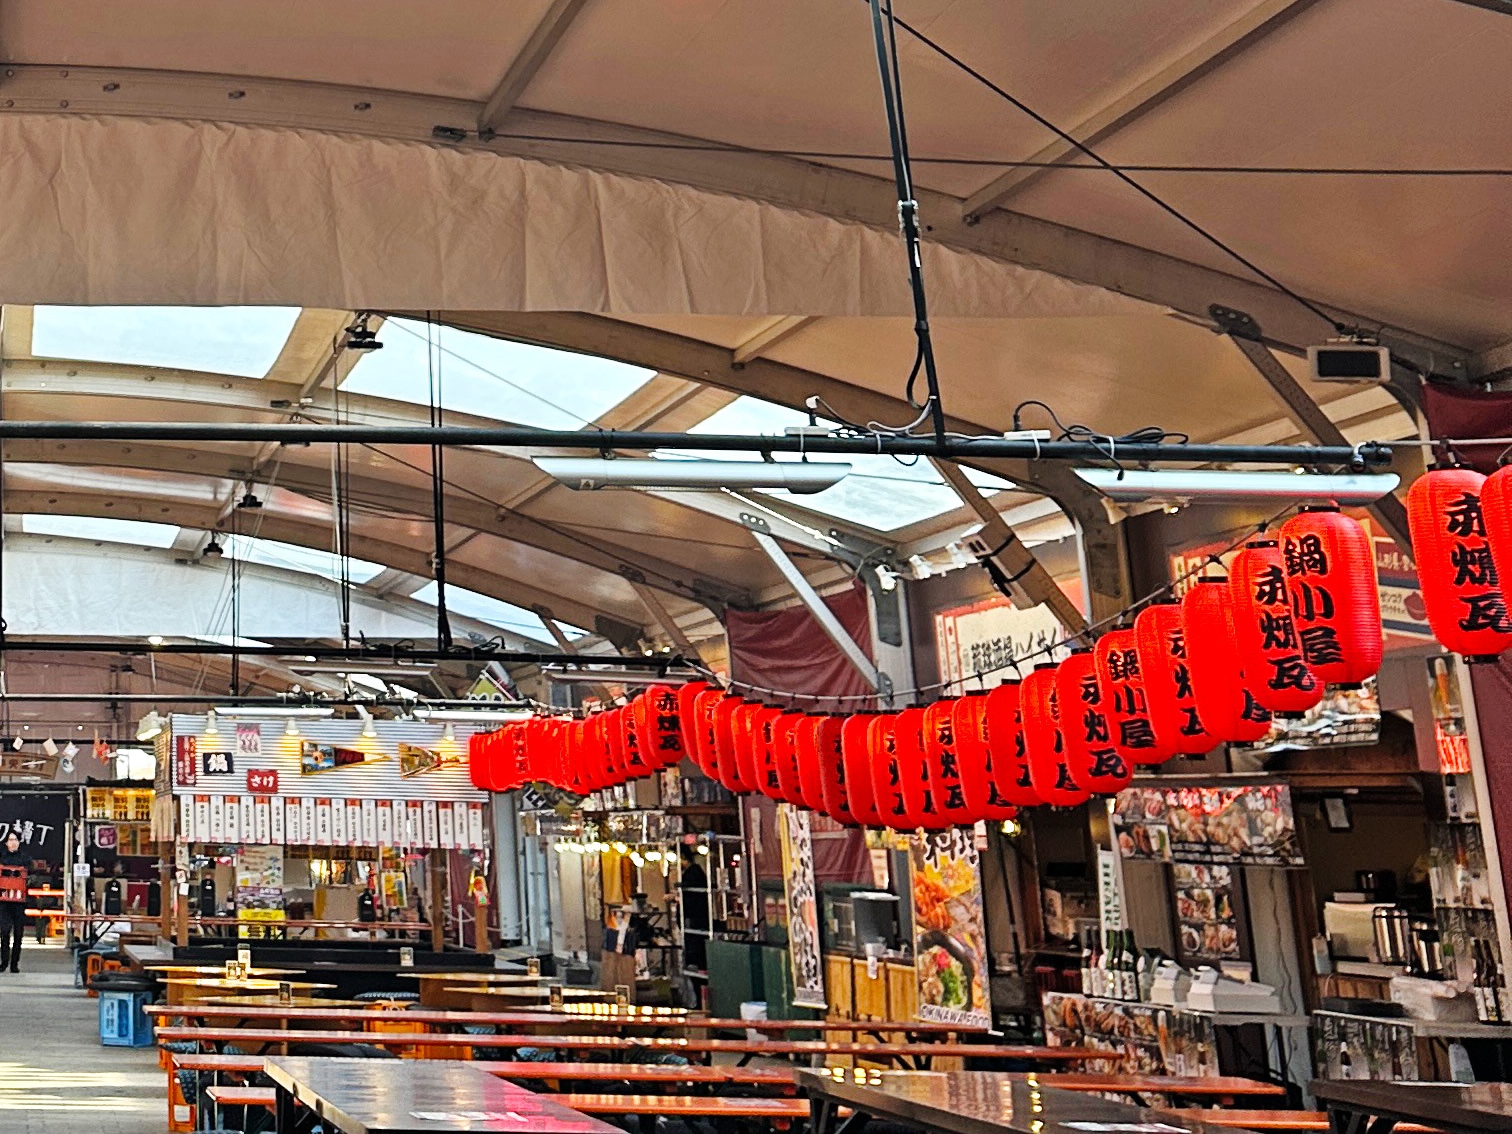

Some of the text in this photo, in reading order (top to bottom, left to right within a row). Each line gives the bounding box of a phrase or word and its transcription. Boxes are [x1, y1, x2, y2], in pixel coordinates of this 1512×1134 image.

[1254, 565, 1315, 691] 赤煉瓦
[1284, 533, 1345, 665] 鍋小屋
[1106, 649, 1158, 749] 鍋小屋
[250, 774, 275, 788] さけ
